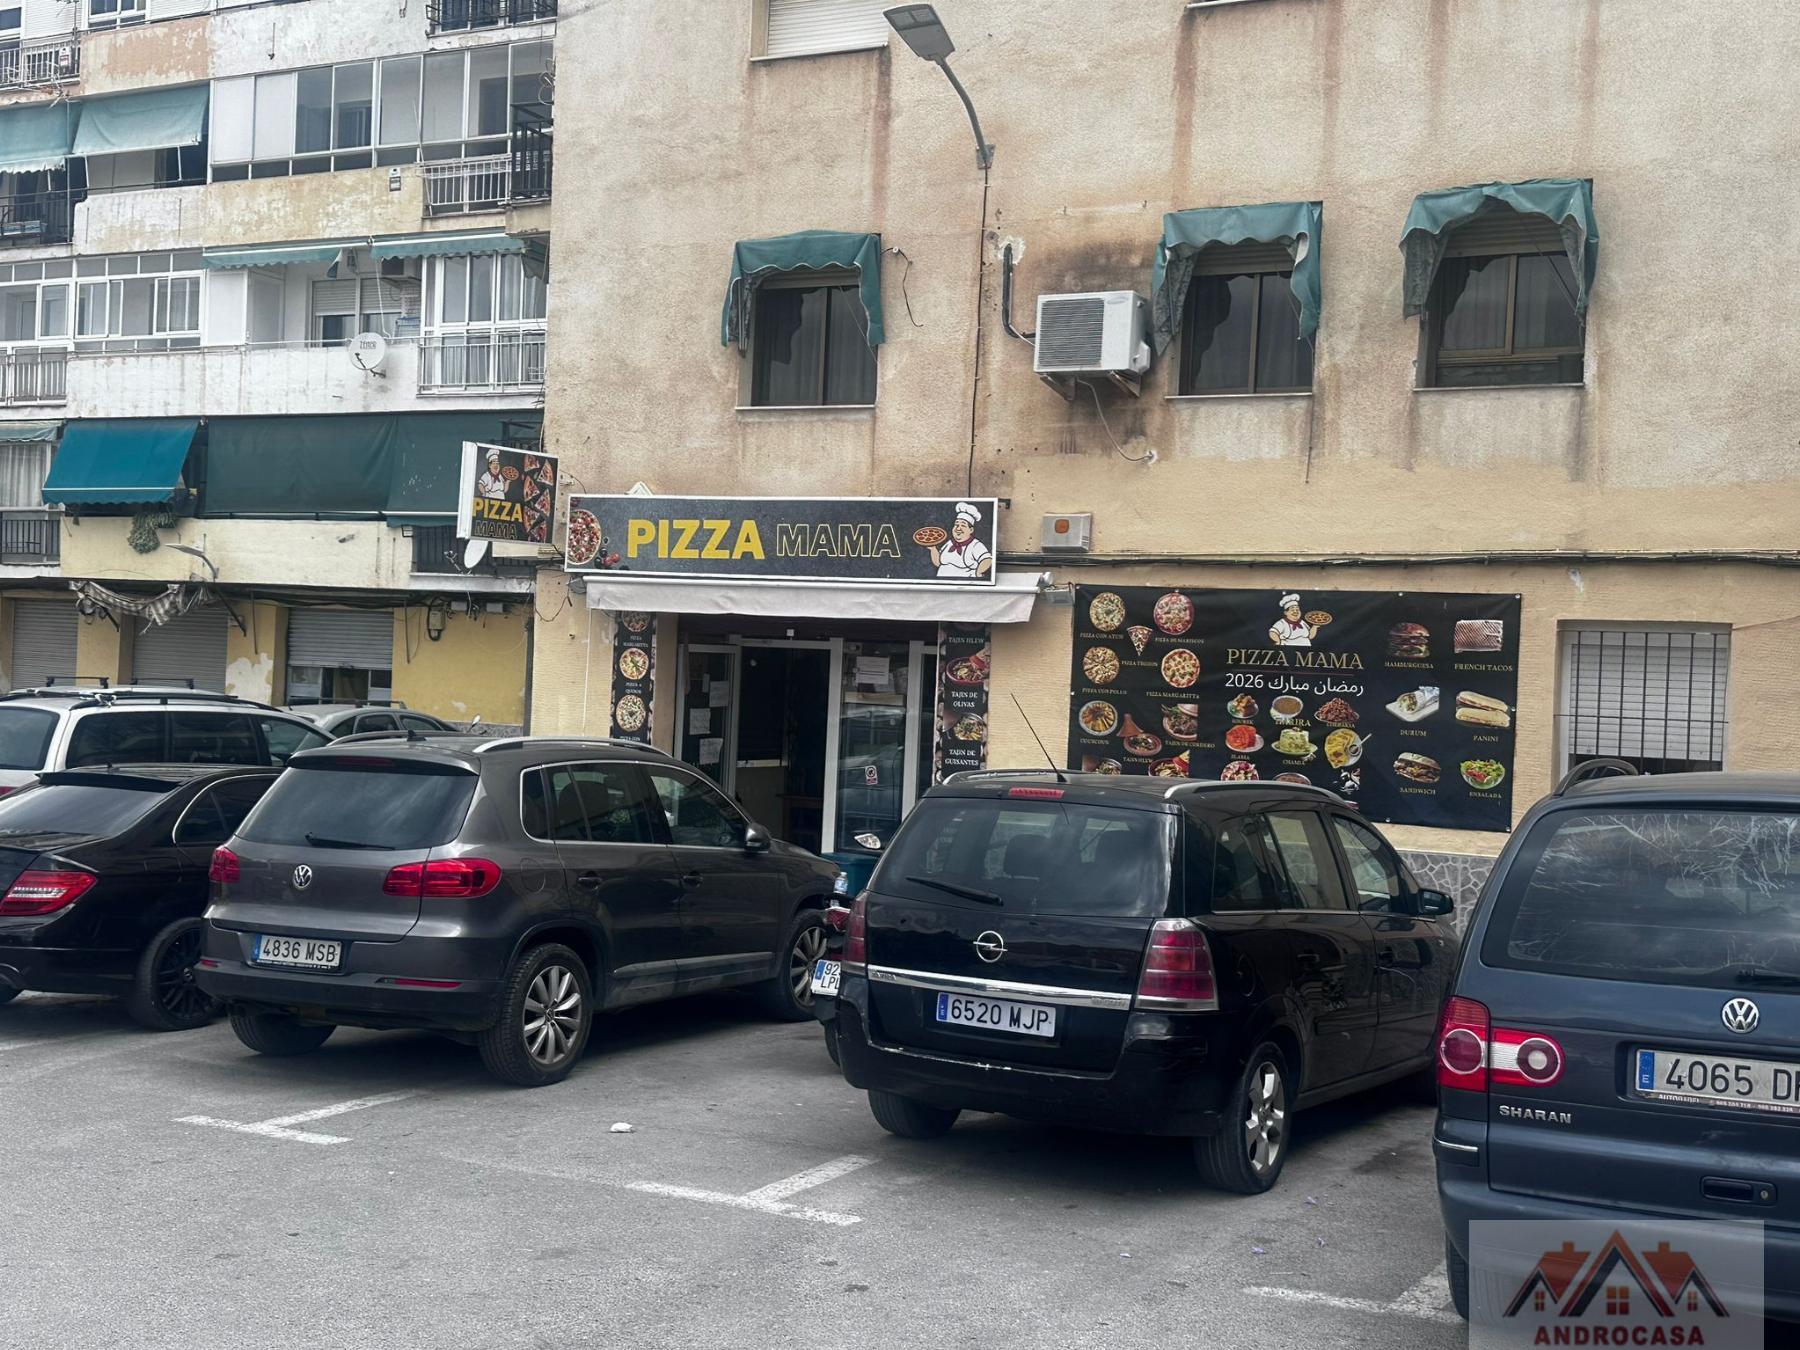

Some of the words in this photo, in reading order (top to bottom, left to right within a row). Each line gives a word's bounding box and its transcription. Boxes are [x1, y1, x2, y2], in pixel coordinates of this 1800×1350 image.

[473, 497, 523, 523] PIZZA
[474, 520, 518, 540] MAMA
[627, 519, 766, 560] PIZZA
[776, 523, 901, 558] MAMA
[1226, 648, 1289, 667] PIZZA
[1295, 650, 1364, 670] MAMA
[1384, 661, 1434, 669] HAMBURGUESA
[1454, 663, 1485, 671] FRENCH
[1487, 664, 1513, 672] TACOS
[1225, 673, 1264, 688] 2026
[1268, 675, 1310, 693] مبارك
[1313, 677, 1364, 696] رمضان
[1400, 729, 1427, 737] DURUM
[1473, 735, 1499, 743] PANINI
[1399, 787, 1436, 796] SANDWICH
[1469, 790, 1502, 798] ENSALADA
[263, 938, 301, 959] 4836
[305, 942, 337, 963] MSB
[824, 962, 841, 976] 92
[951, 999, 1002, 1025] 6520
[1009, 1006, 1049, 1031] MJP
[1642, 1074, 1650, 1083] E
[1666, 1058, 1754, 1096] 4065
[1499, 1104, 1572, 1124] SHARAN
